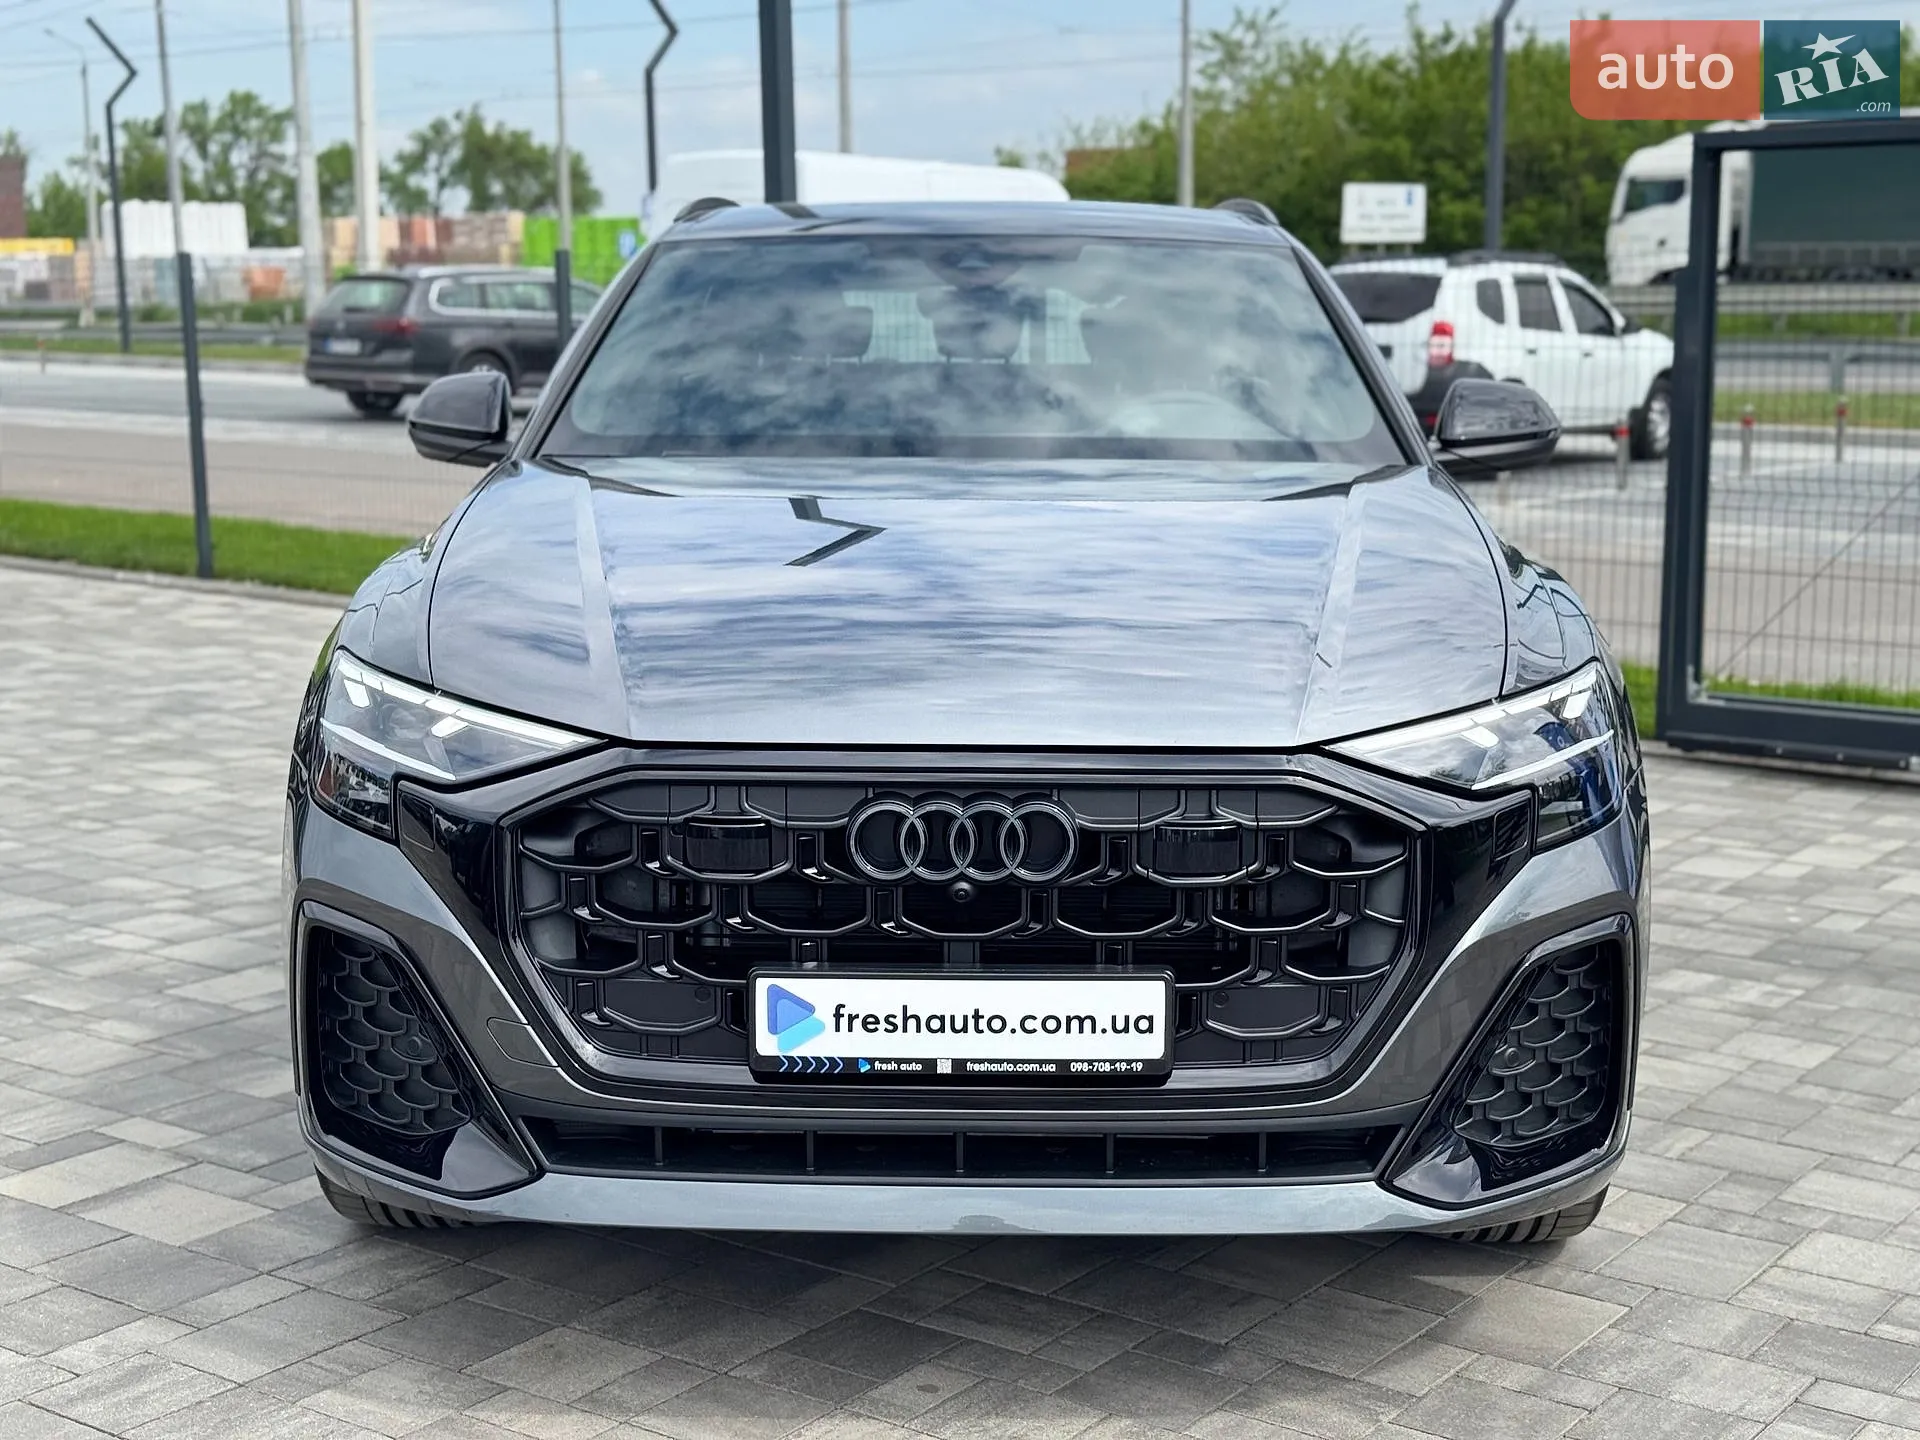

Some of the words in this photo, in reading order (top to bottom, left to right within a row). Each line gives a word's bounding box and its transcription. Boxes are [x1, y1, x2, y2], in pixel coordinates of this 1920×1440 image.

[832, 1004, 1154, 1035] freshauto.com.ua
[874, 1060, 898, 1071] fresh
[899, 1061, 923, 1071] auto
[966, 1060, 1056, 1073] freshauto.com.ua
[1070, 1061, 1144, 1073] 098-708-19-19
